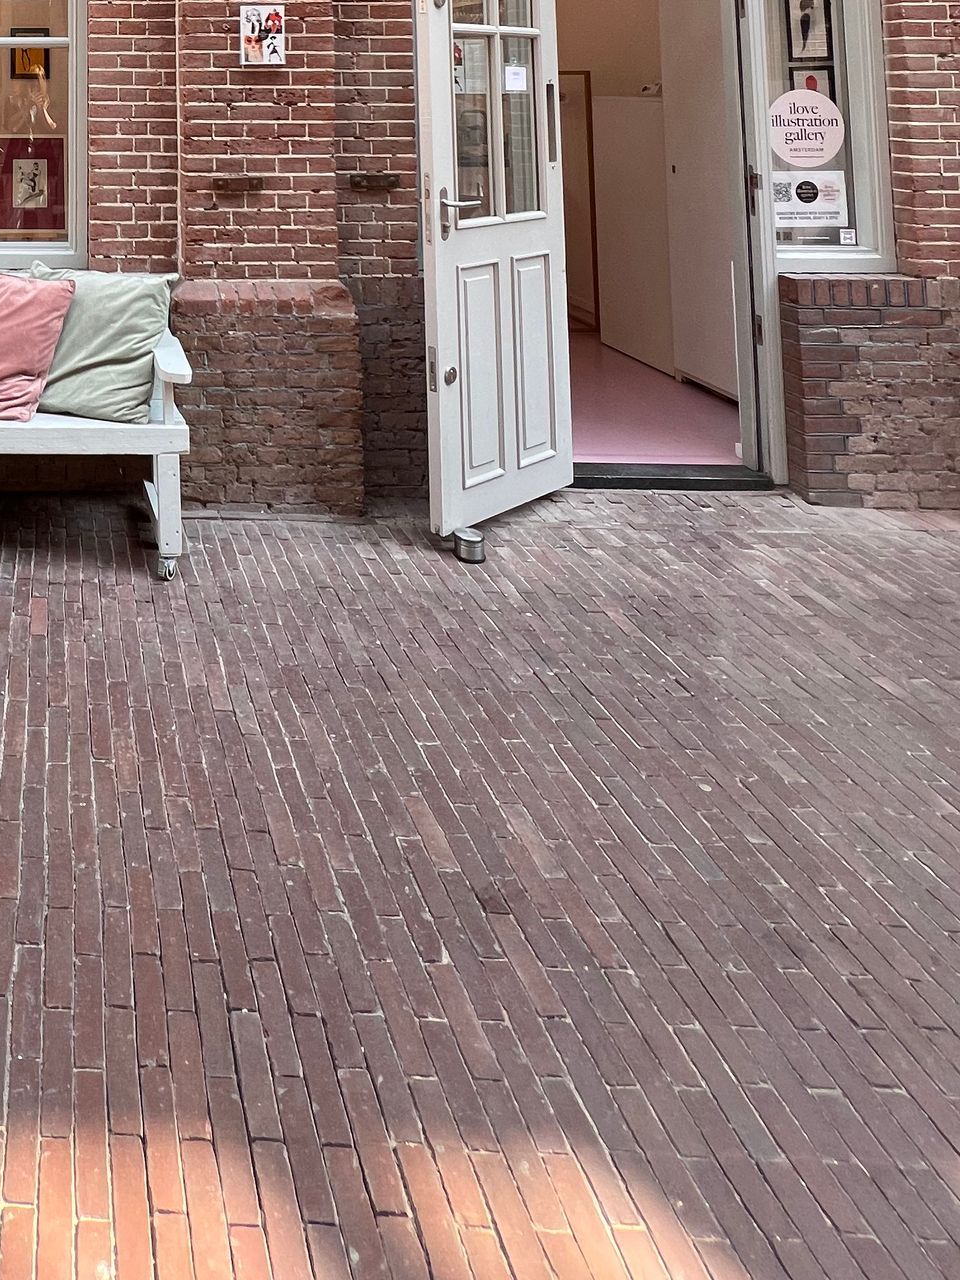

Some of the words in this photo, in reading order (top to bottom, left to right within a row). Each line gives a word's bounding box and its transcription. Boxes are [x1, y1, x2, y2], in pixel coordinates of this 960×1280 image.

[788, 102, 819, 115] ilove
[771, 114, 839, 127] illustration
[784, 128, 826, 145] gallery
